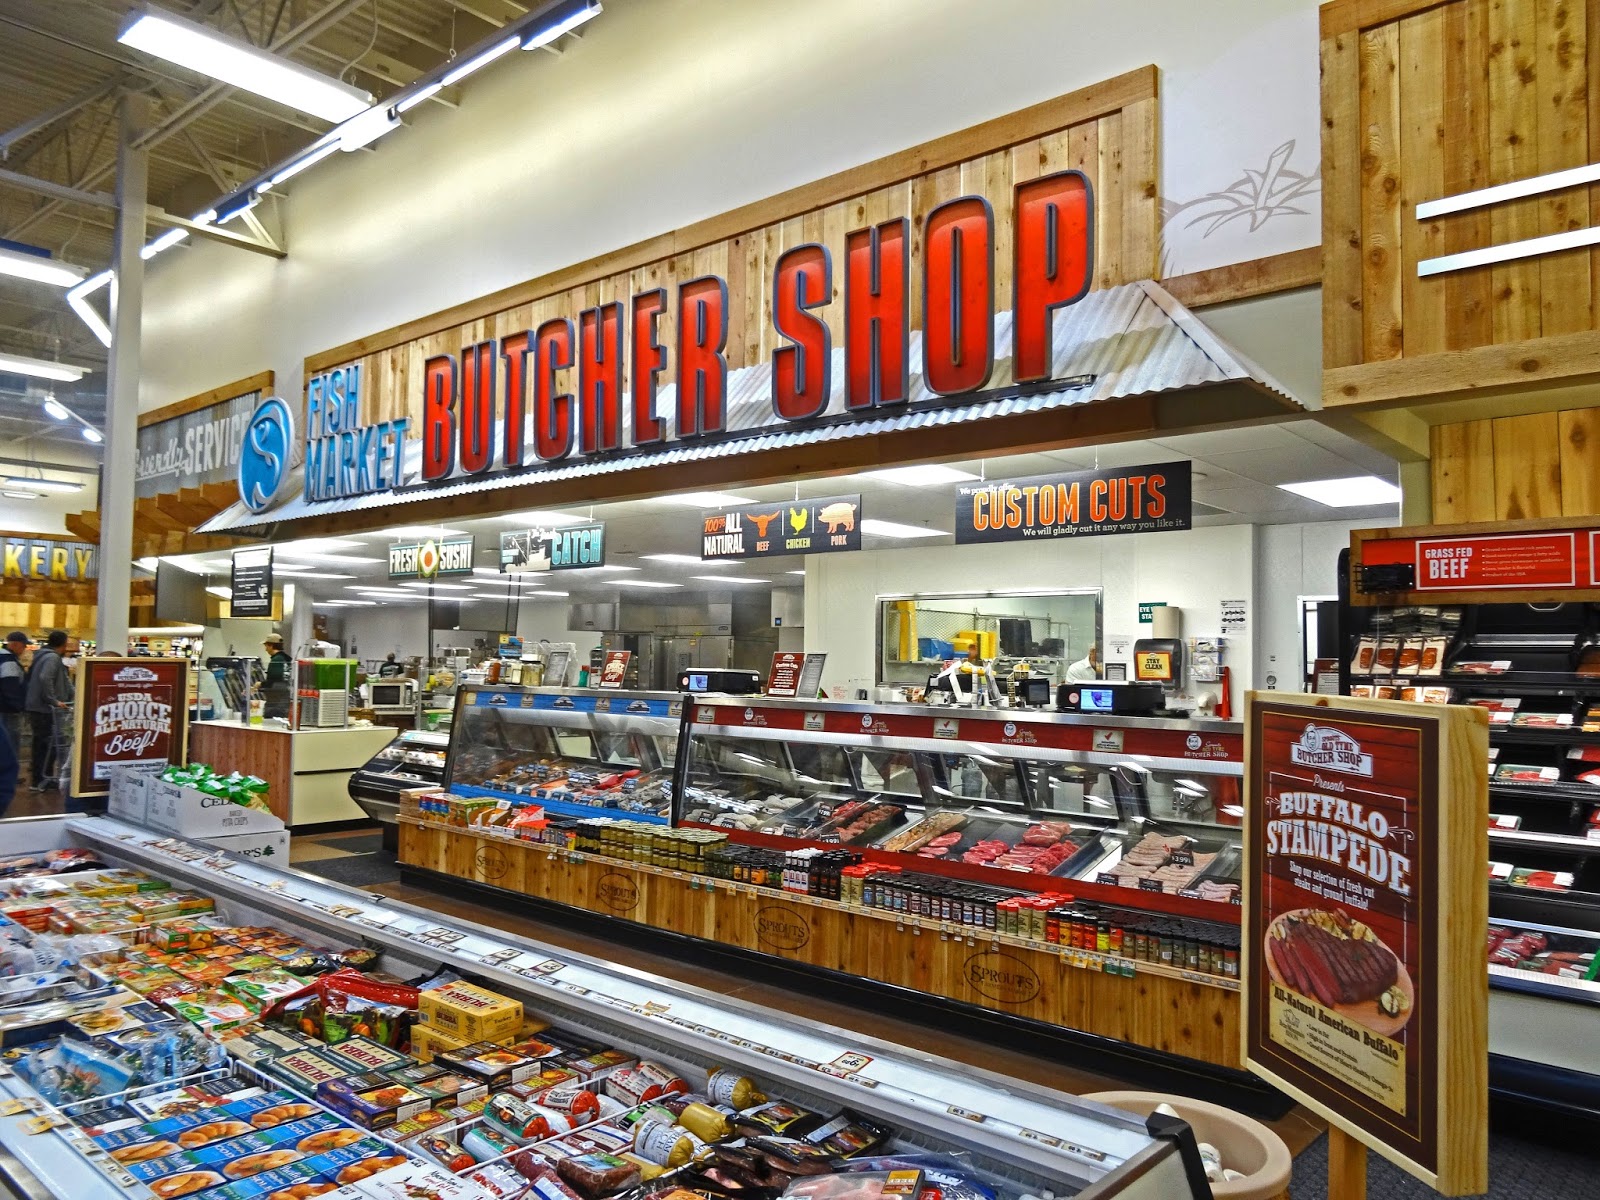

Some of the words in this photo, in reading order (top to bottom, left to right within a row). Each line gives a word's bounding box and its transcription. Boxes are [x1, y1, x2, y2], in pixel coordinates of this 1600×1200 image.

[422, 274, 728, 482] BUTCHER
[772, 169, 1094, 421] SHOP
[307, 363, 363, 440] FISH
[135, 437, 184, 478] riendly
[304, 417, 412, 502] MARKET
[973, 481, 1080, 532] CUSTOM
[1089, 474, 1167, 523] CUTS
[704, 517, 726, 533] 100%
[724, 512, 743, 534] ALL
[1022, 528, 1037, 536] We
[1037, 526, 1052, 535] will
[1053, 524, 1078, 537] gladly
[1079, 525, 1093, 533] cut
[1093, 523, 1101, 532] it
[1102, 524, 1118, 534] any
[1119, 522, 1137, 532] way
[1138, 520, 1155, 531] you
[1156, 518, 1174, 528] like
[551, 529, 602, 565] CATCH
[703, 533, 745, 556] NATURAL
[756, 541, 770, 552] BEEF
[785, 537, 811, 550] CHICKEN
[830, 534, 847, 546] PORK
[1425, 548, 1454, 559] GRASS
[1455, 547, 1473, 557] FED
[4, 543, 94, 582] KERY
[389, 546, 418, 573] FRESH
[439, 543, 472, 571] SUSHI
[1429, 557, 1469, 580] BEEF
[117, 692, 153, 702] USDA
[95, 700, 172, 725] CHOICE
[94, 719, 172, 737] ALL-NATURAL
[104, 725, 161, 757] Beef!
[1296, 747, 1335, 764] BUTCHER
[1337, 751, 1363, 767] SHOP
[1313, 773, 1345, 793] Presents
[201, 797, 233, 809] CED
[1279, 791, 1389, 839] BUFFALO
[238, 847, 262, 857] R'S
[1266, 818, 1412, 895] STAMPEDE
[601, 883, 637, 900] SPROUTS
[1289, 860, 1302, 877] Shop
[1302, 867, 1313, 879] our
[1312, 869, 1338, 887] selection
[1338, 877, 1346, 889] of
[1346, 878, 1363, 895] fresh
[1363, 887, 1375, 899] cut
[1311, 883, 1323, 895] and
[1323, 888, 1344, 903] ground
[758, 917, 806, 938] SPROUTS
[970, 964, 1034, 990] SPROUTS
[446, 990, 489, 1008] BUBBA
[1274, 986, 1316, 1018] All-Natural
[1318, 1010, 1361, 1043] American
[1363, 1028, 1399, 1062] Buffalo
[338, 1042, 385, 1068] BUBBA
[283, 1055, 333, 1083] BUBBA
